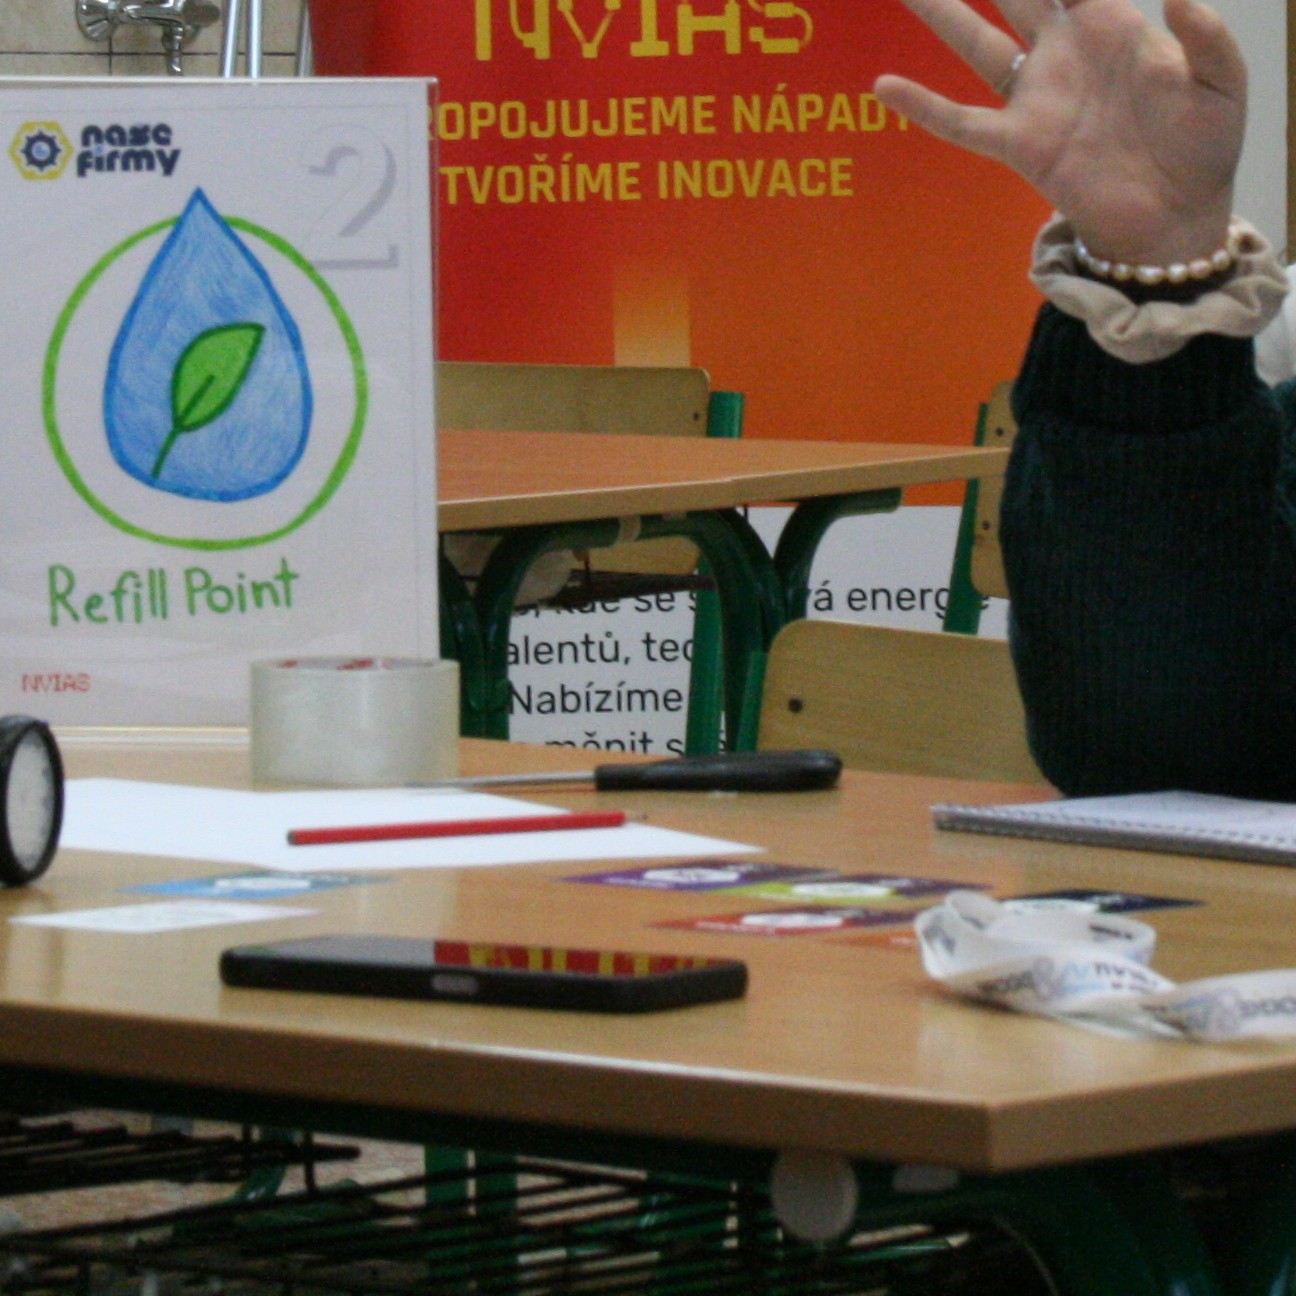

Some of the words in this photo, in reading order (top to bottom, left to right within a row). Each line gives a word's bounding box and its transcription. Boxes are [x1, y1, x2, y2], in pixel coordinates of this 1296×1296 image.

[76, 143, 182, 178] firmy
[439, 153, 642, 204] TVOŘÍME
[657, 157, 854, 201] INOVACE
[47, 565, 168, 626] Refill
[185, 557, 300, 618] Point
[507, 629, 631, 666] alentů,
[20, 672, 91, 693] NVIAS
[507, 680, 684, 715] Nabízíme
